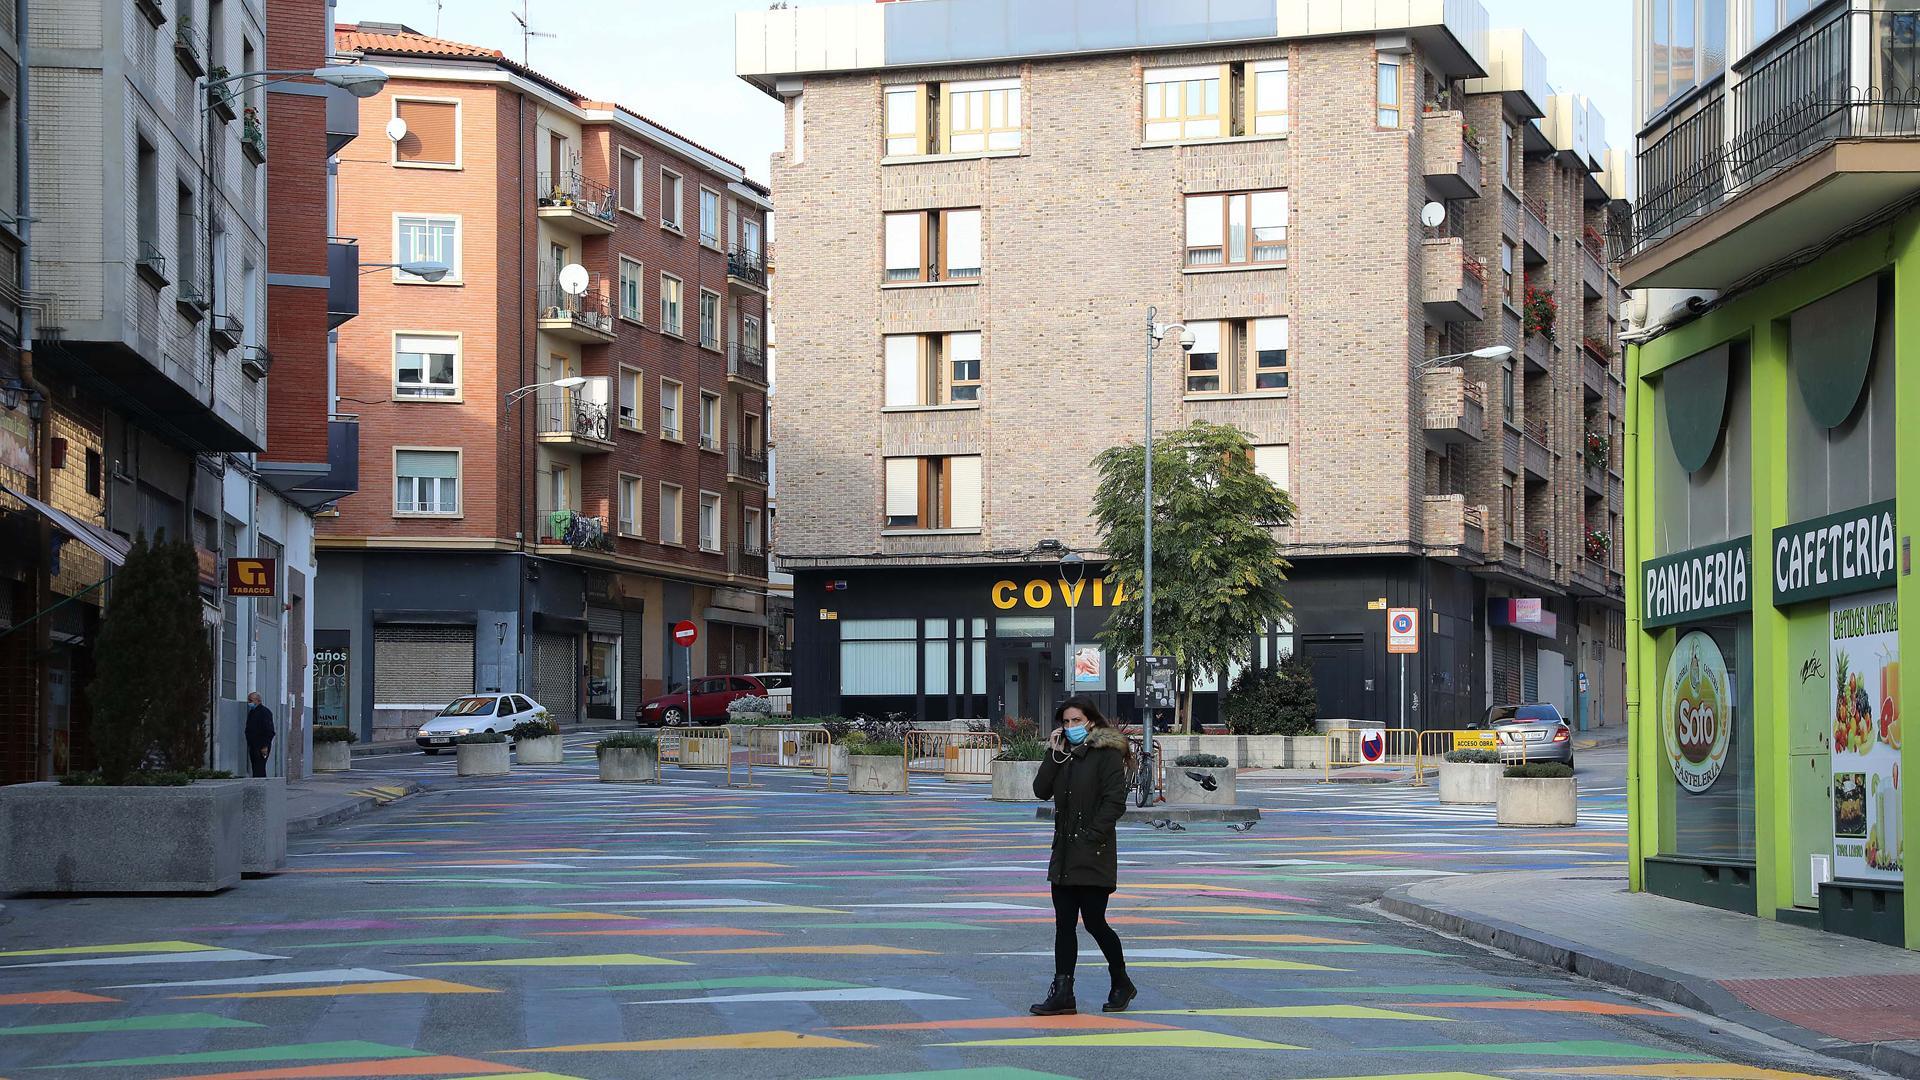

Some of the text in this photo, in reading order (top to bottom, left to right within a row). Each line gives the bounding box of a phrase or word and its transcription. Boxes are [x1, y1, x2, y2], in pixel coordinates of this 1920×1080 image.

[1776, 511, 1894, 592] CAFETERIA
[1647, 547, 1746, 618] PANADERIA
[1834, 606, 1865, 640] BATIDOS
[1679, 698, 1715, 745] Soto
[1674, 759, 1720, 787] PASTELERÍA
